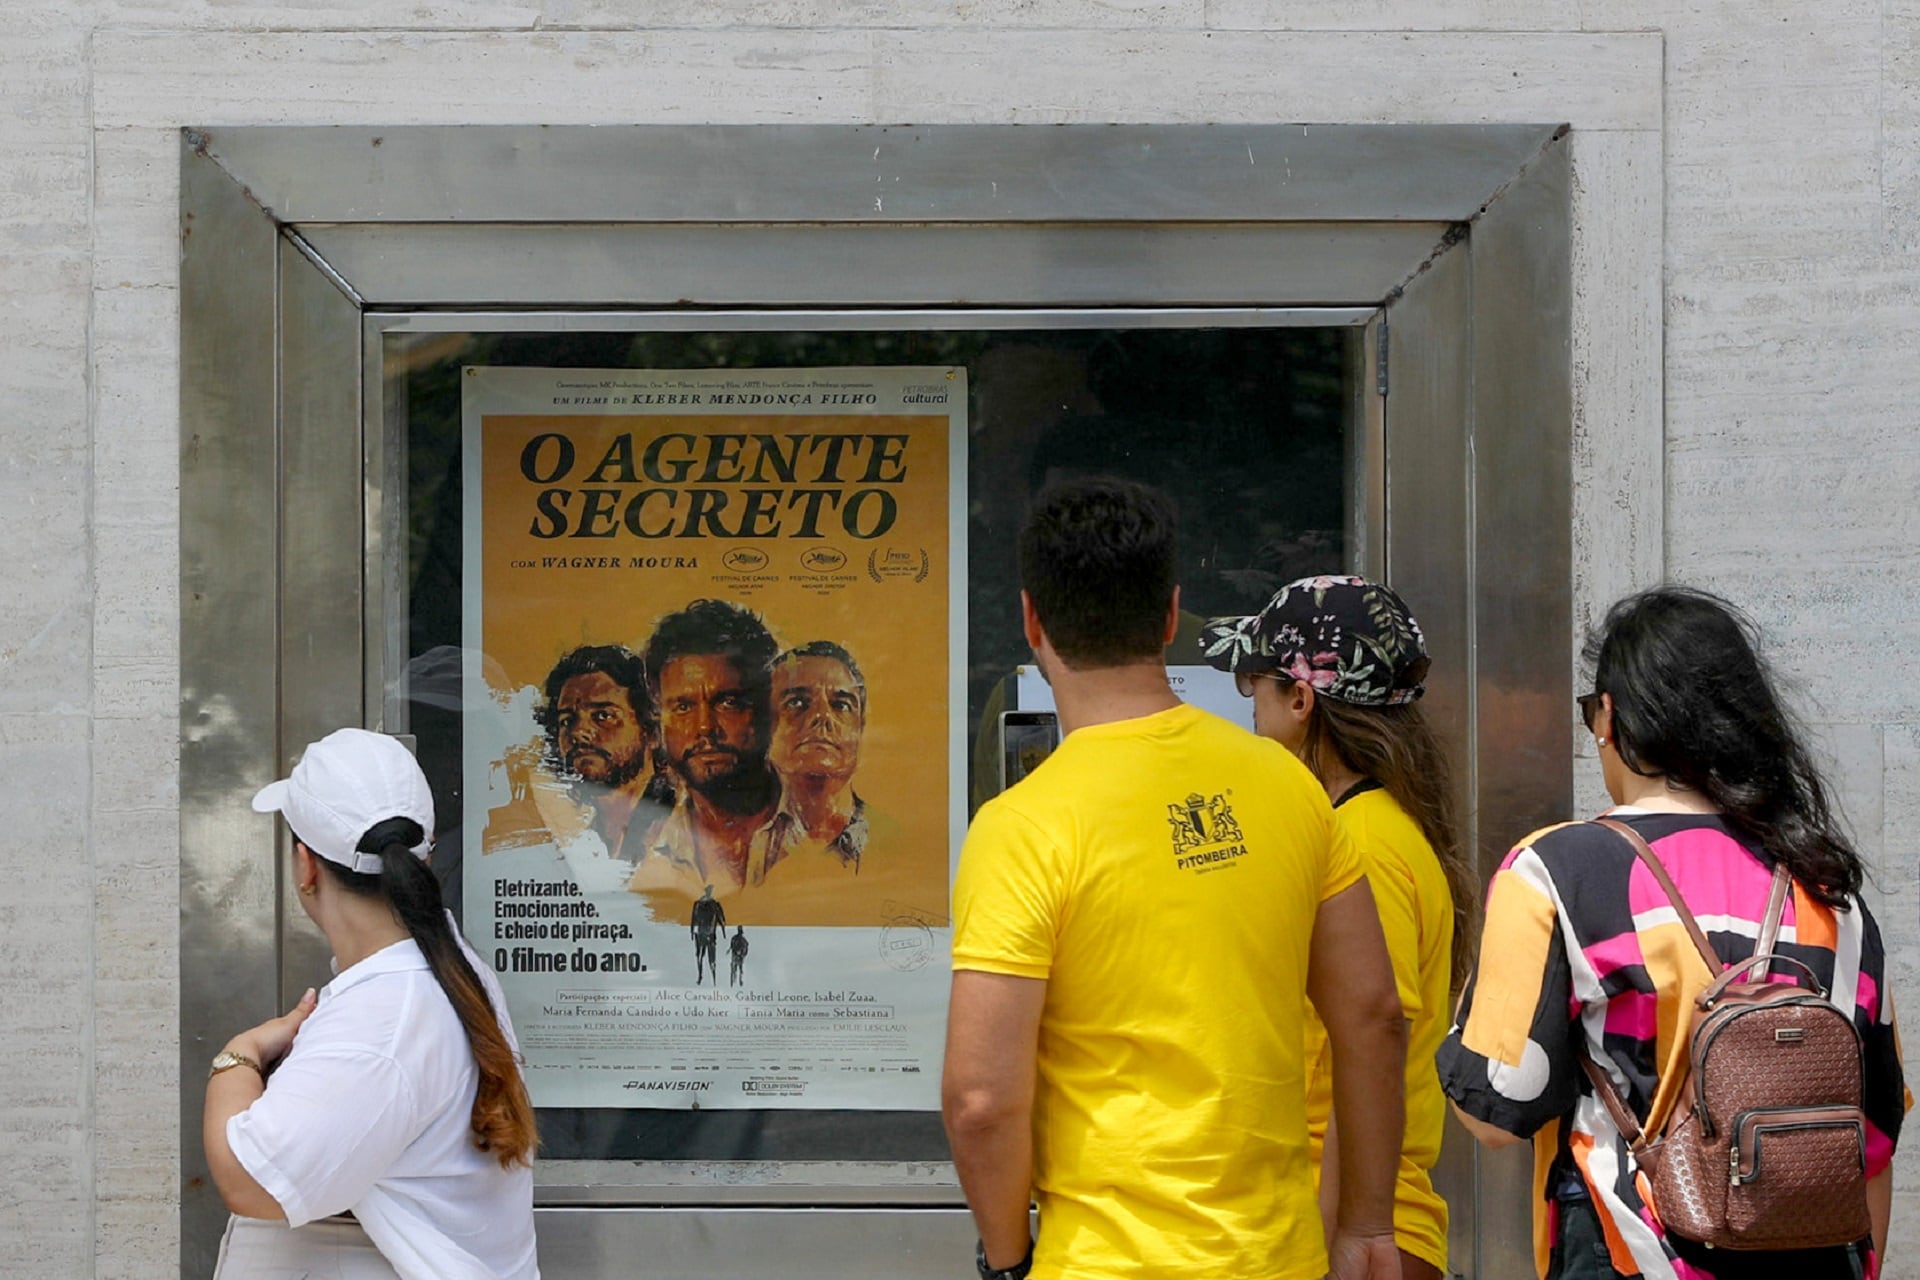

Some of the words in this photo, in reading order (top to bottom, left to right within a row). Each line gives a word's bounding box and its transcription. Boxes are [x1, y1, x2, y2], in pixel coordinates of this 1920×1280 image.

[632, 394, 701, 404] KLEBER
[708, 394, 812, 408] MENDONÇA
[820, 394, 877, 404] FILHO
[903, 393, 948, 404] cultural
[520, 433, 576, 483] O
[583, 433, 910, 484] AGENTE
[529, 488, 898, 539] SECRETO
[510, 560, 536, 568] COM
[542, 557, 621, 568] WAGNER
[630, 557, 698, 568] MOURA
[1178, 844, 1248, 870] PITOMBEIRA
[494, 879, 583, 897] Eletrizante.
[494, 900, 600, 918] Emocionante.
[494, 922, 503, 939] E
[504, 921, 548, 939] cheio
[550, 921, 570, 939] de
[572, 921, 633, 943] pirraça.
[494, 948, 508, 972] O
[511, 947, 567, 972] filme
[570, 947, 598, 972] do
[600, 952, 648, 972] ano.
[656, 990, 681, 1000] Alice
[735, 990, 774, 1002] Gabriel
[815, 991, 844, 1002] Isabel
[543, 1006, 572, 1016] Maria
[576, 1006, 623, 1016] Fernanda
[682, 1006, 704, 1016] Udo
[708, 1007, 728, 1017] Kier
[776, 1007, 805, 1018] Maria
[833, 1007, 888, 1018] Sebastiana
[618, 1024, 670, 1032] MENDONÇA
[714, 1024, 751, 1032] WAGNER
[754, 1024, 786, 1032] MOURA
[622, 1081, 710, 1091] PANAVISION
